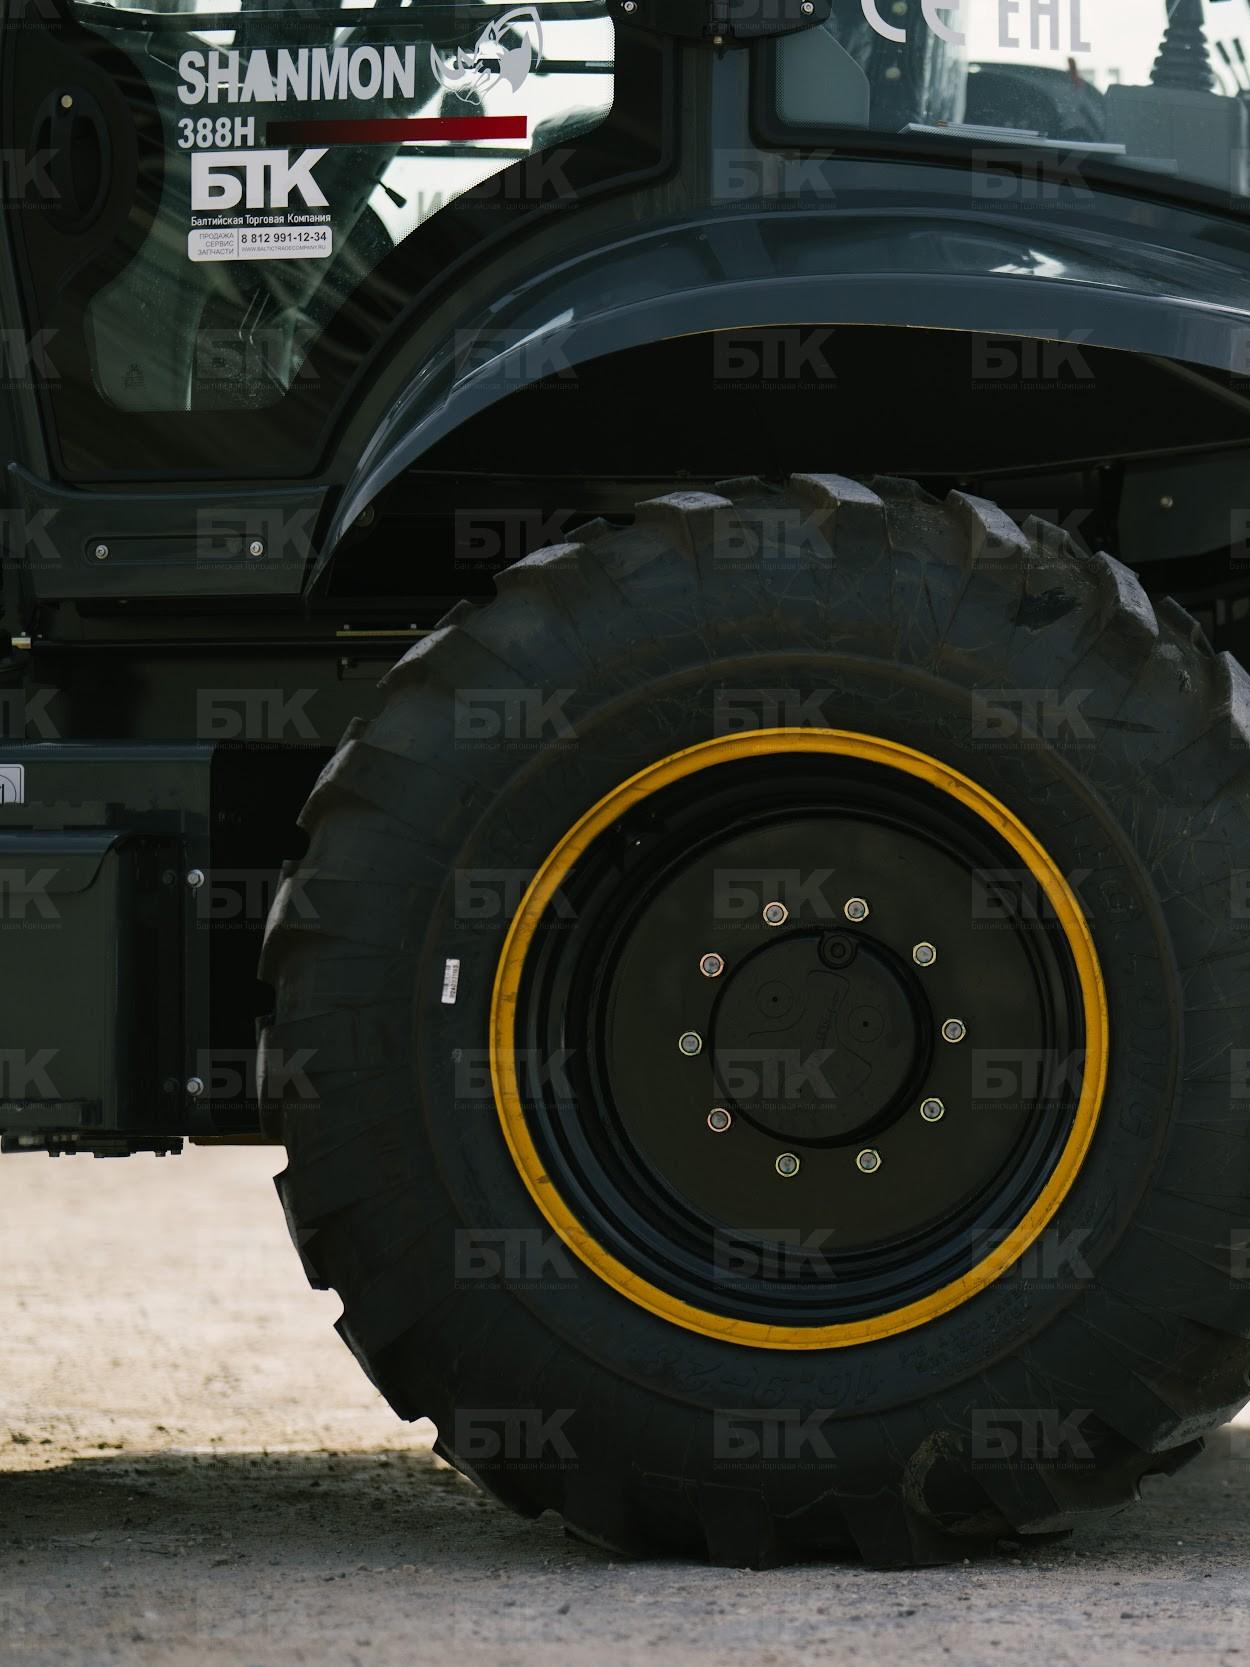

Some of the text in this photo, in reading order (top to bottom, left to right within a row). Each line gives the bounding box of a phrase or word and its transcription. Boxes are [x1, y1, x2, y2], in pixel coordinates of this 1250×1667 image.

[178, 45, 416, 105] SHANMON
[177, 116, 256, 149] 388H
[191, 148, 331, 211] БТК
[191, 213, 332, 227] Балтийская Торговая Компания
[205, 240, 235, 248] СЕРВИС
[241, 231, 327, 244] 8 812 991-12-34
